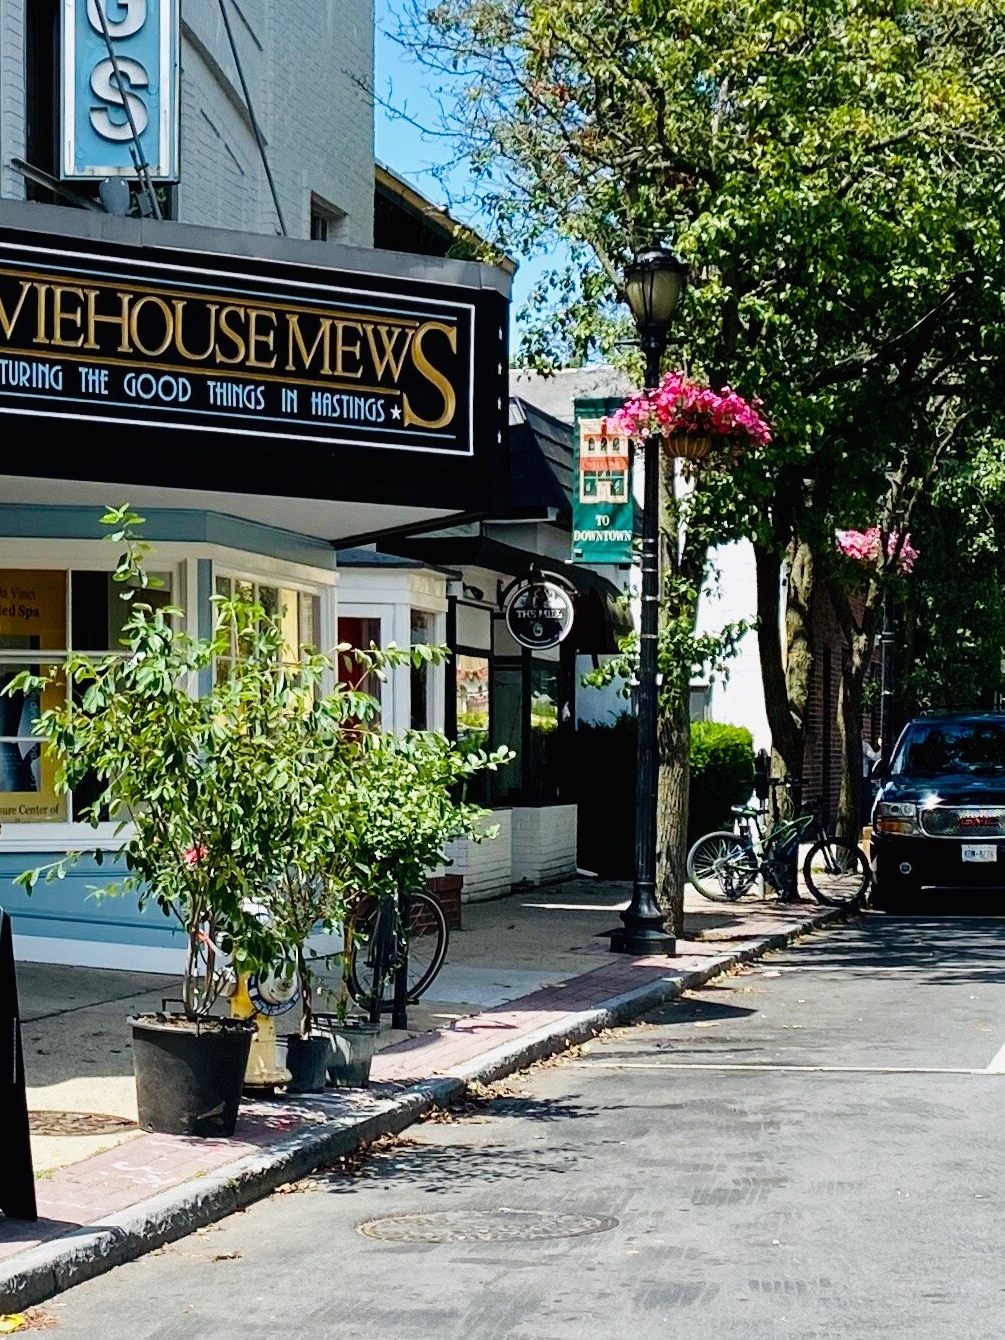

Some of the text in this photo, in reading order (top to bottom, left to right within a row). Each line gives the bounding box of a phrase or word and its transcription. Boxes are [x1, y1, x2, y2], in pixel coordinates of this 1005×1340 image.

[285, 313, 458, 430] MEWS
[78, 366, 109, 395] THE
[123, 372, 192, 403] GOOD
[207, 380, 266, 410] THINGS
[281, 388, 298, 413] IN
[311, 391, 386, 423] HASTINGS
[595, 514, 610, 527] TO
[573, 529, 632, 542] DOWNTOWN
[18, 604, 40, 620] Spa
[18, 803, 48, 816] Center
[50, 802, 60, 815] of
